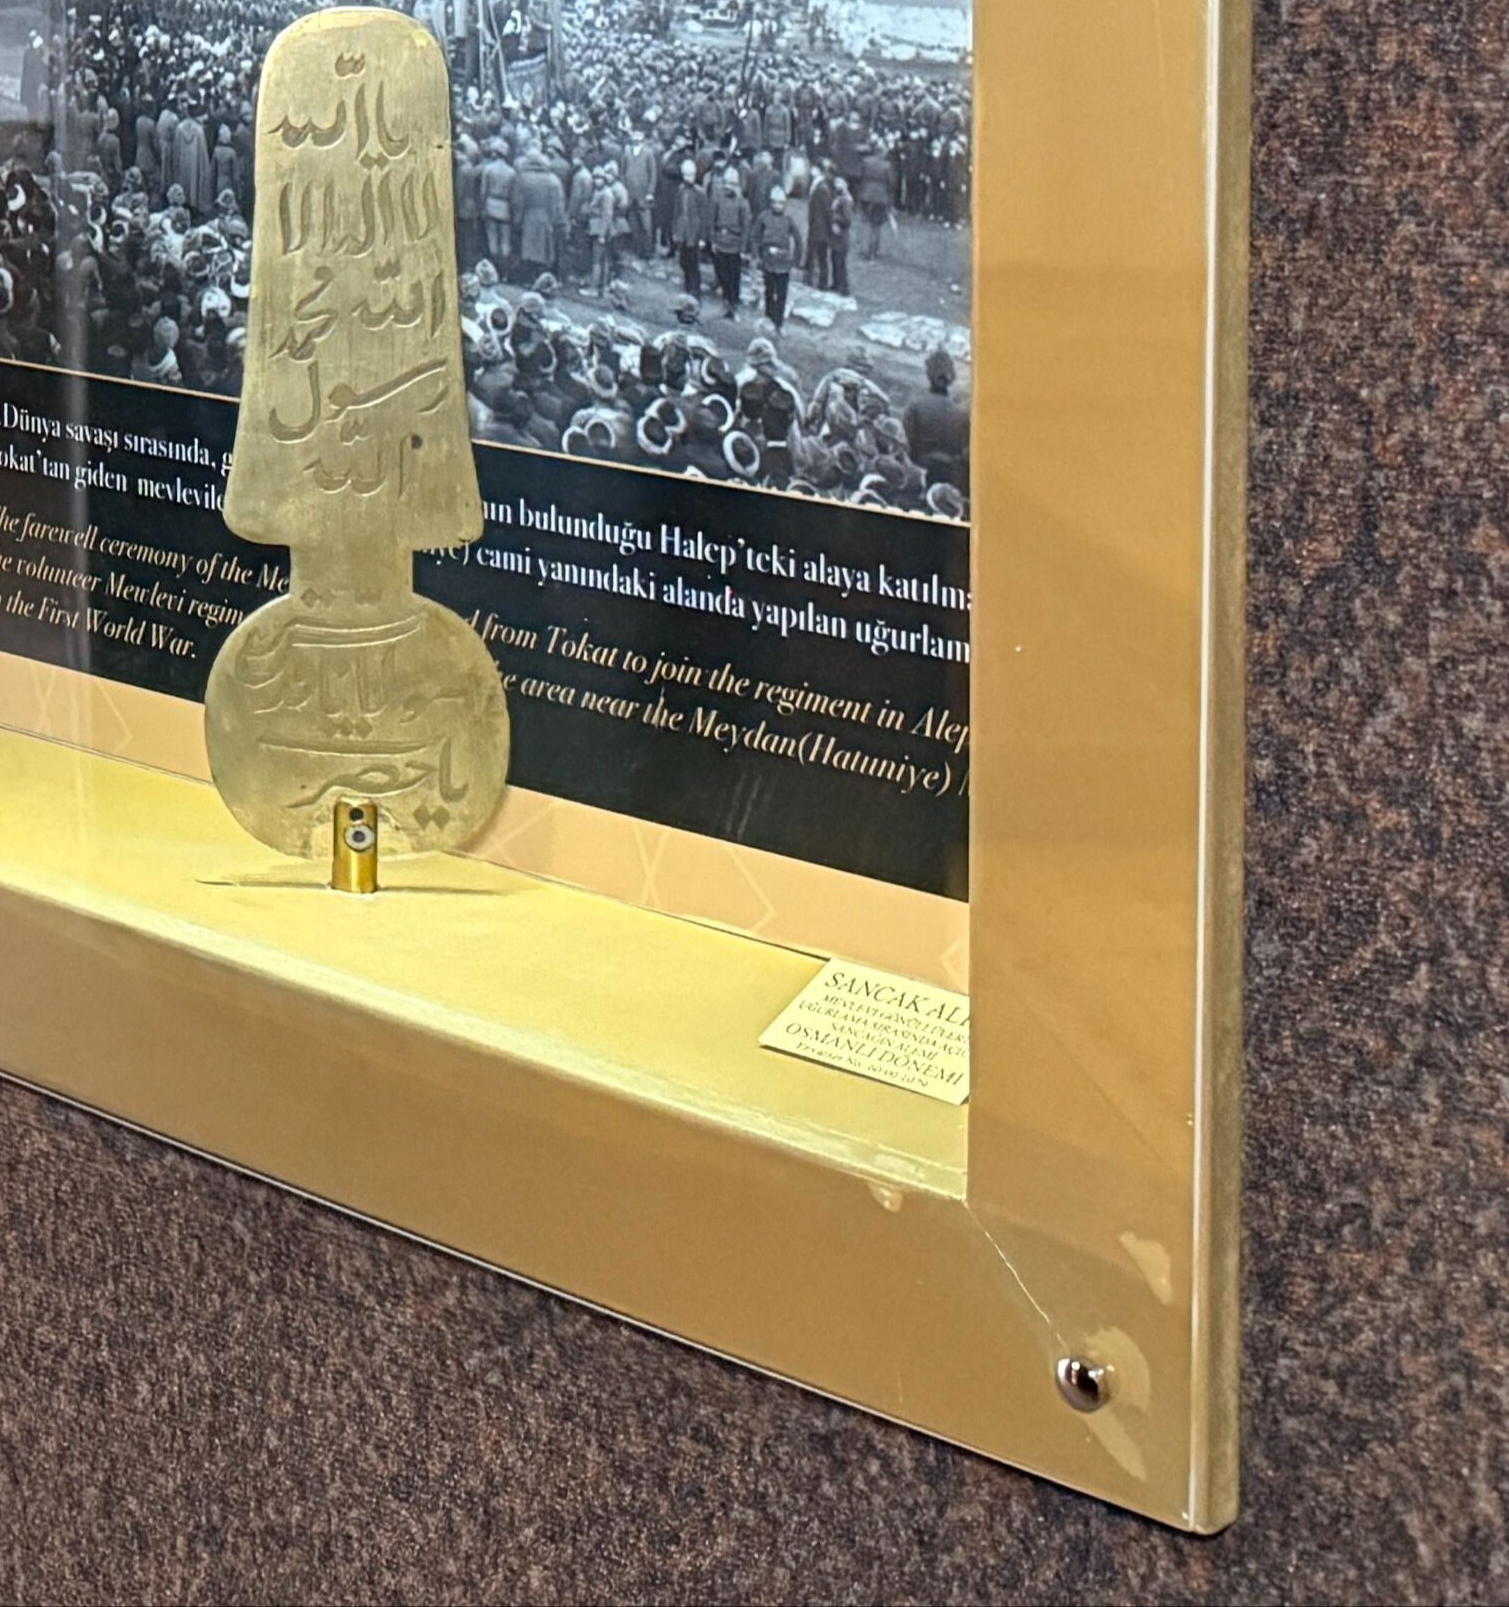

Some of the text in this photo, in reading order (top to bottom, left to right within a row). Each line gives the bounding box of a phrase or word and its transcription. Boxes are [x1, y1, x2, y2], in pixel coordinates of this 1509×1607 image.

[65, 421, 119, 454] savaşı
[124, 431, 217, 469] sırasında,
[74, 457, 128, 493] giden
[16, 513, 98, 551] farewell
[99, 534, 193, 579] ceremony
[196, 553, 223, 585] of
[221, 556, 253, 585] the
[519, 498, 652, 556] bulunduğu
[803, 553, 870, 599] alaya
[16, 556, 102, 592] volunteer
[105, 571, 187, 613] Mewlevi
[476, 546, 531, 576] cami
[537, 557, 656, 601] yanındaki
[662, 577, 745, 619] alanda
[751, 601, 847, 638] yapılan
[5, 591, 34, 618] the
[38, 596, 80, 630] First
[85, 607, 145, 646] World
[151, 623, 196, 659] War.
[480, 612, 538, 651] from
[546, 625, 619, 668] Tokat
[622, 650, 647, 674] to
[644, 651, 703, 686] join
[707, 662, 751, 697] the
[754, 682, 873, 724] regiment
[876, 699, 906, 731] in
[520, 675, 576, 705] area
[581, 689, 640, 720] near
[642, 698, 684, 732] the
[688, 706, 952, 798] Meydan(Hatuniye)
[824, 972, 930, 1013] SANCAK
[786, 1023, 878, 1058] OSMANLI
